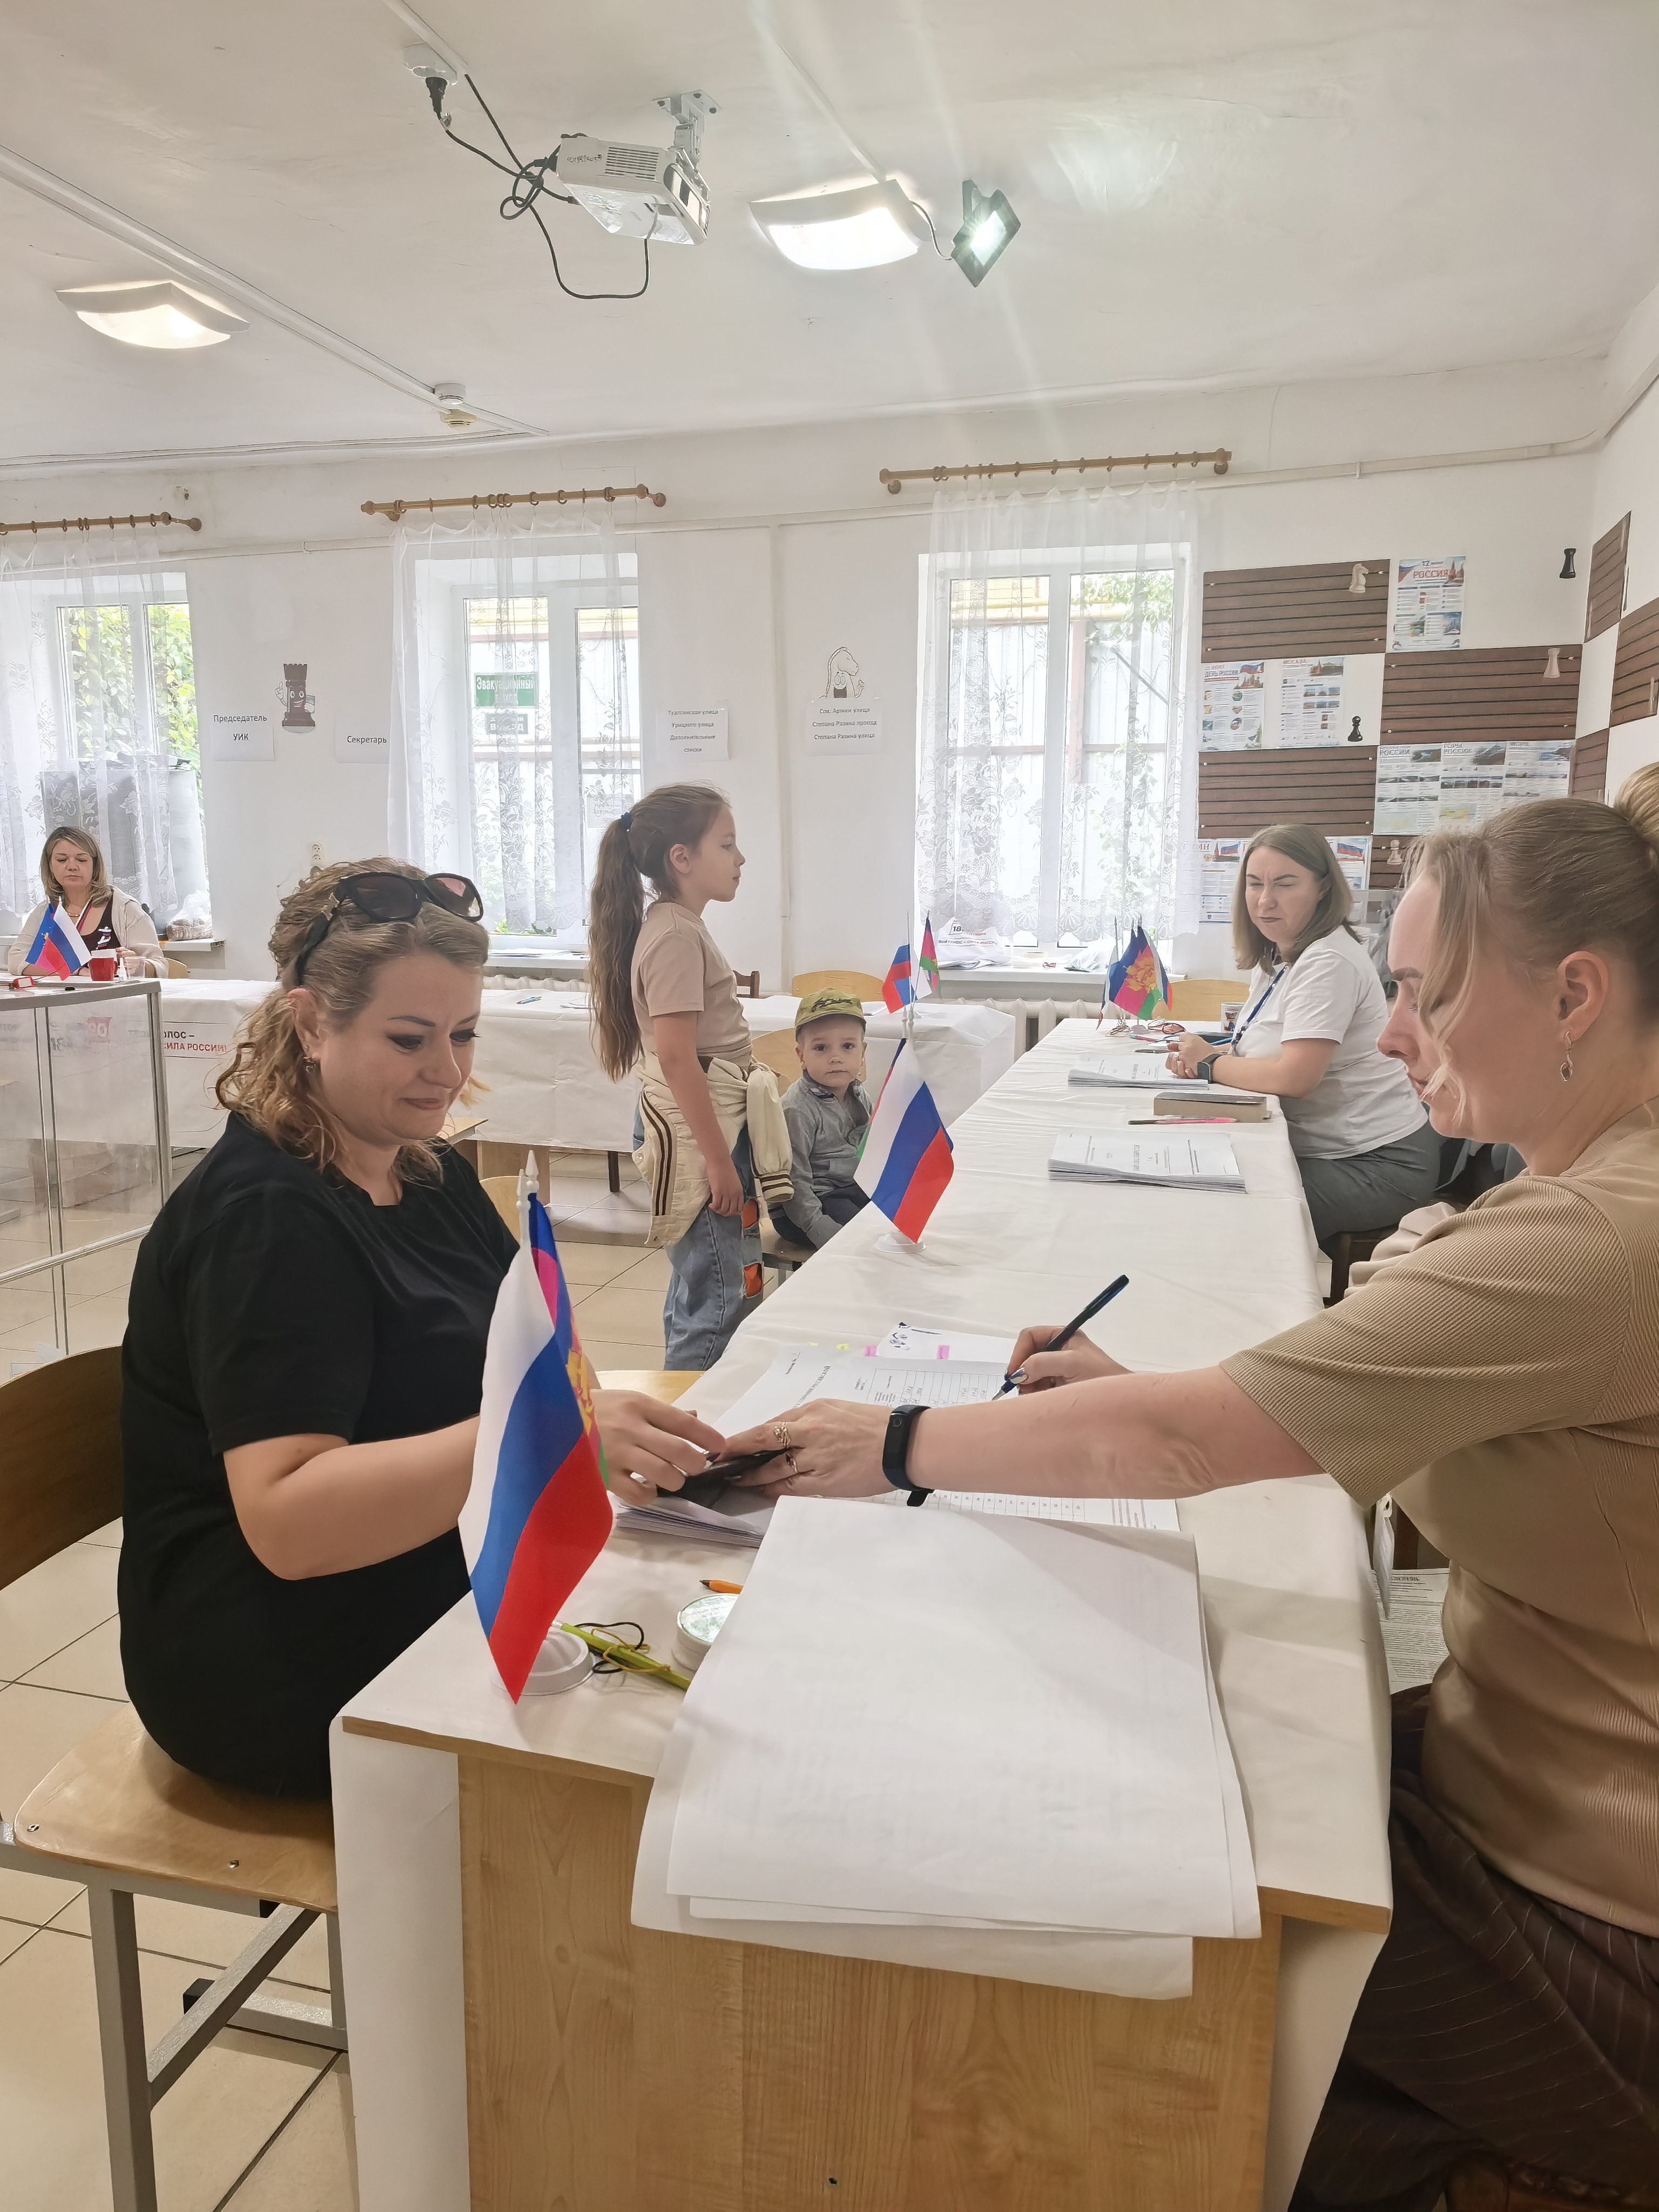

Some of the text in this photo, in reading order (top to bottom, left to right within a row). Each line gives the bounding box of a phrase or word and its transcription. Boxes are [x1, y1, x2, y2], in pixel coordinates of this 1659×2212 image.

[1413, 569, 1449, 578] РОССИЯ
[213, 715, 267, 723] Председатель
[347, 736, 387, 745] Секретарь
[164, 1042, 185, 1050] ИЛА
